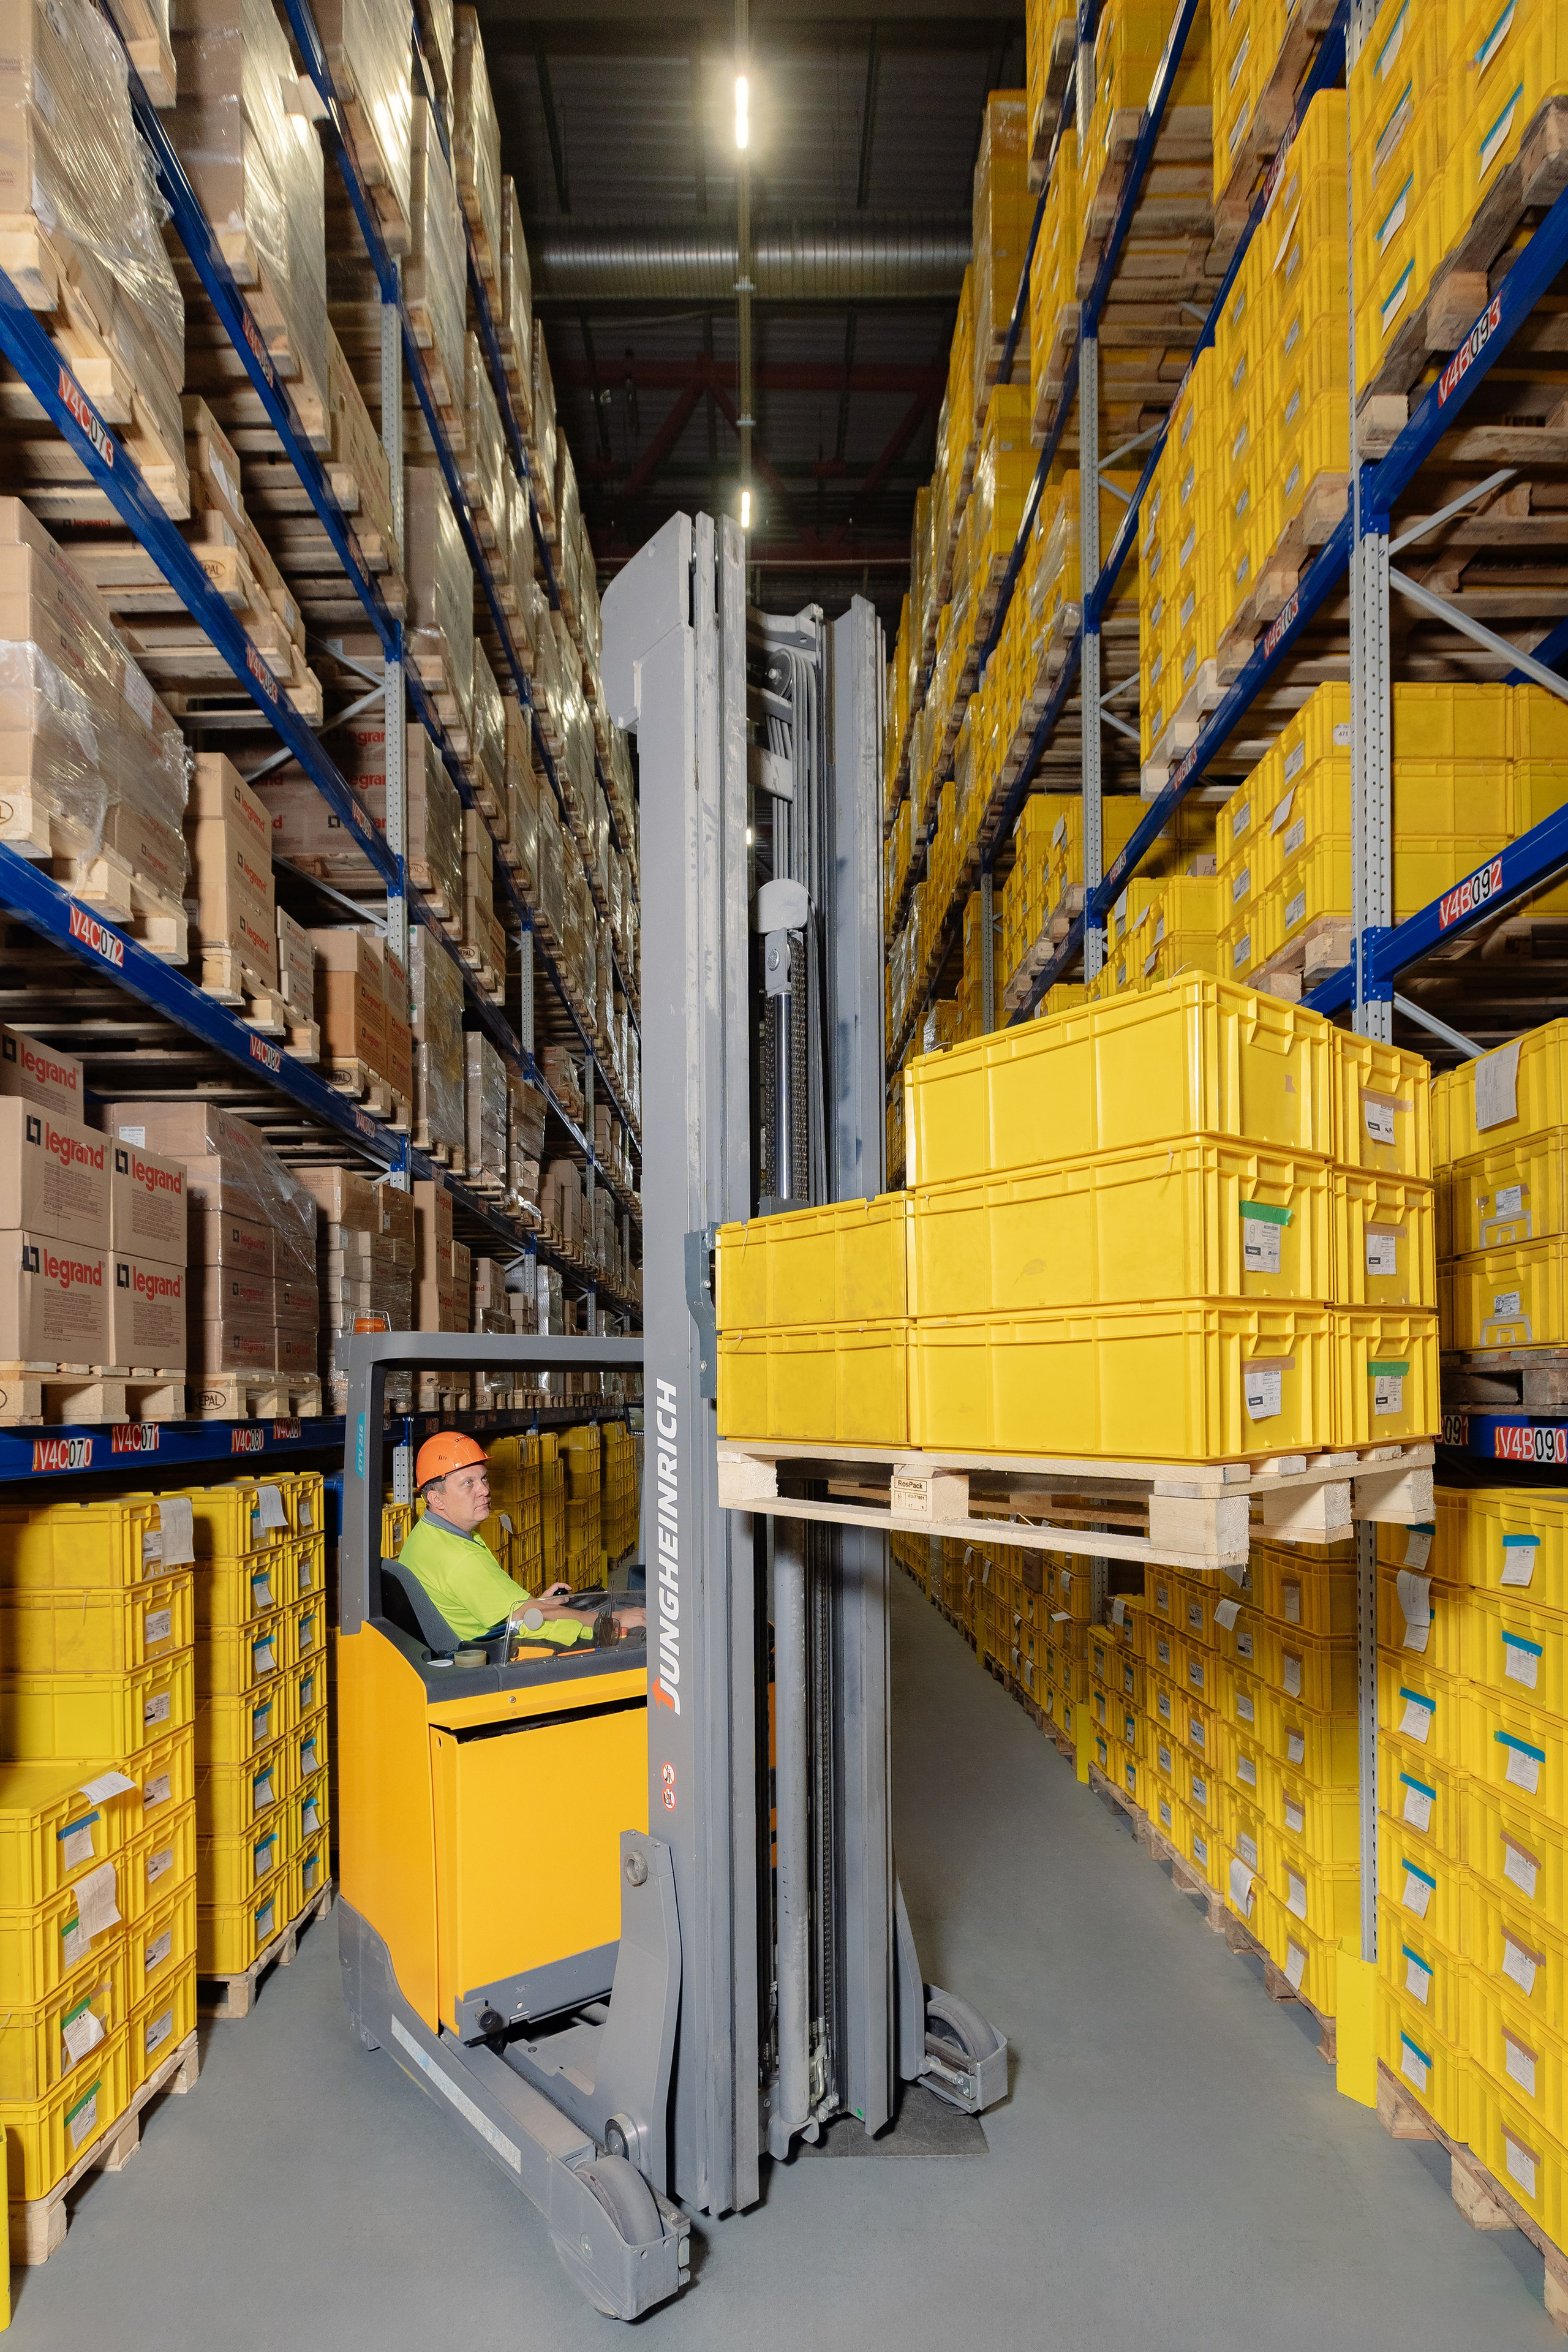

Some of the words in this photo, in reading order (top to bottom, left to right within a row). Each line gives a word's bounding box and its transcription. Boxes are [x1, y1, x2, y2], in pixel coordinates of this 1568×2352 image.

[1439, 295, 1501, 403] V4B093
[61, 366, 114, 468] V4C073
[247, 645, 277, 703] V4C083
[241, 794, 265, 833] legrand
[244, 858, 266, 895] legrand
[1440, 859, 1502, 927] V4B092
[70, 905, 123, 968] V4C072
[246, 921, 269, 954] legrand
[21, 1042, 77, 1090] legrand
[251, 1033, 280, 1074] V4C082
[45, 1122, 104, 1170] legrand
[132, 1154, 182, 1195] legrand
[43, 1248, 102, 1289] legrand
[133, 1265, 181, 1301] legrand
[198, 1395, 221, 1407] EPAL
[116, 1423, 159, 1452] V4C071
[234, 1428, 264, 1452] V4C080
[276, 1417, 301, 1439] V4C081
[1500, 1428, 1567, 1462] V4B090
[38, 1438, 92, 1469] V4C070
[898, 1480, 923, 1489] RosPack
[651, 1378, 681, 1715] JUNGHEINRICH
